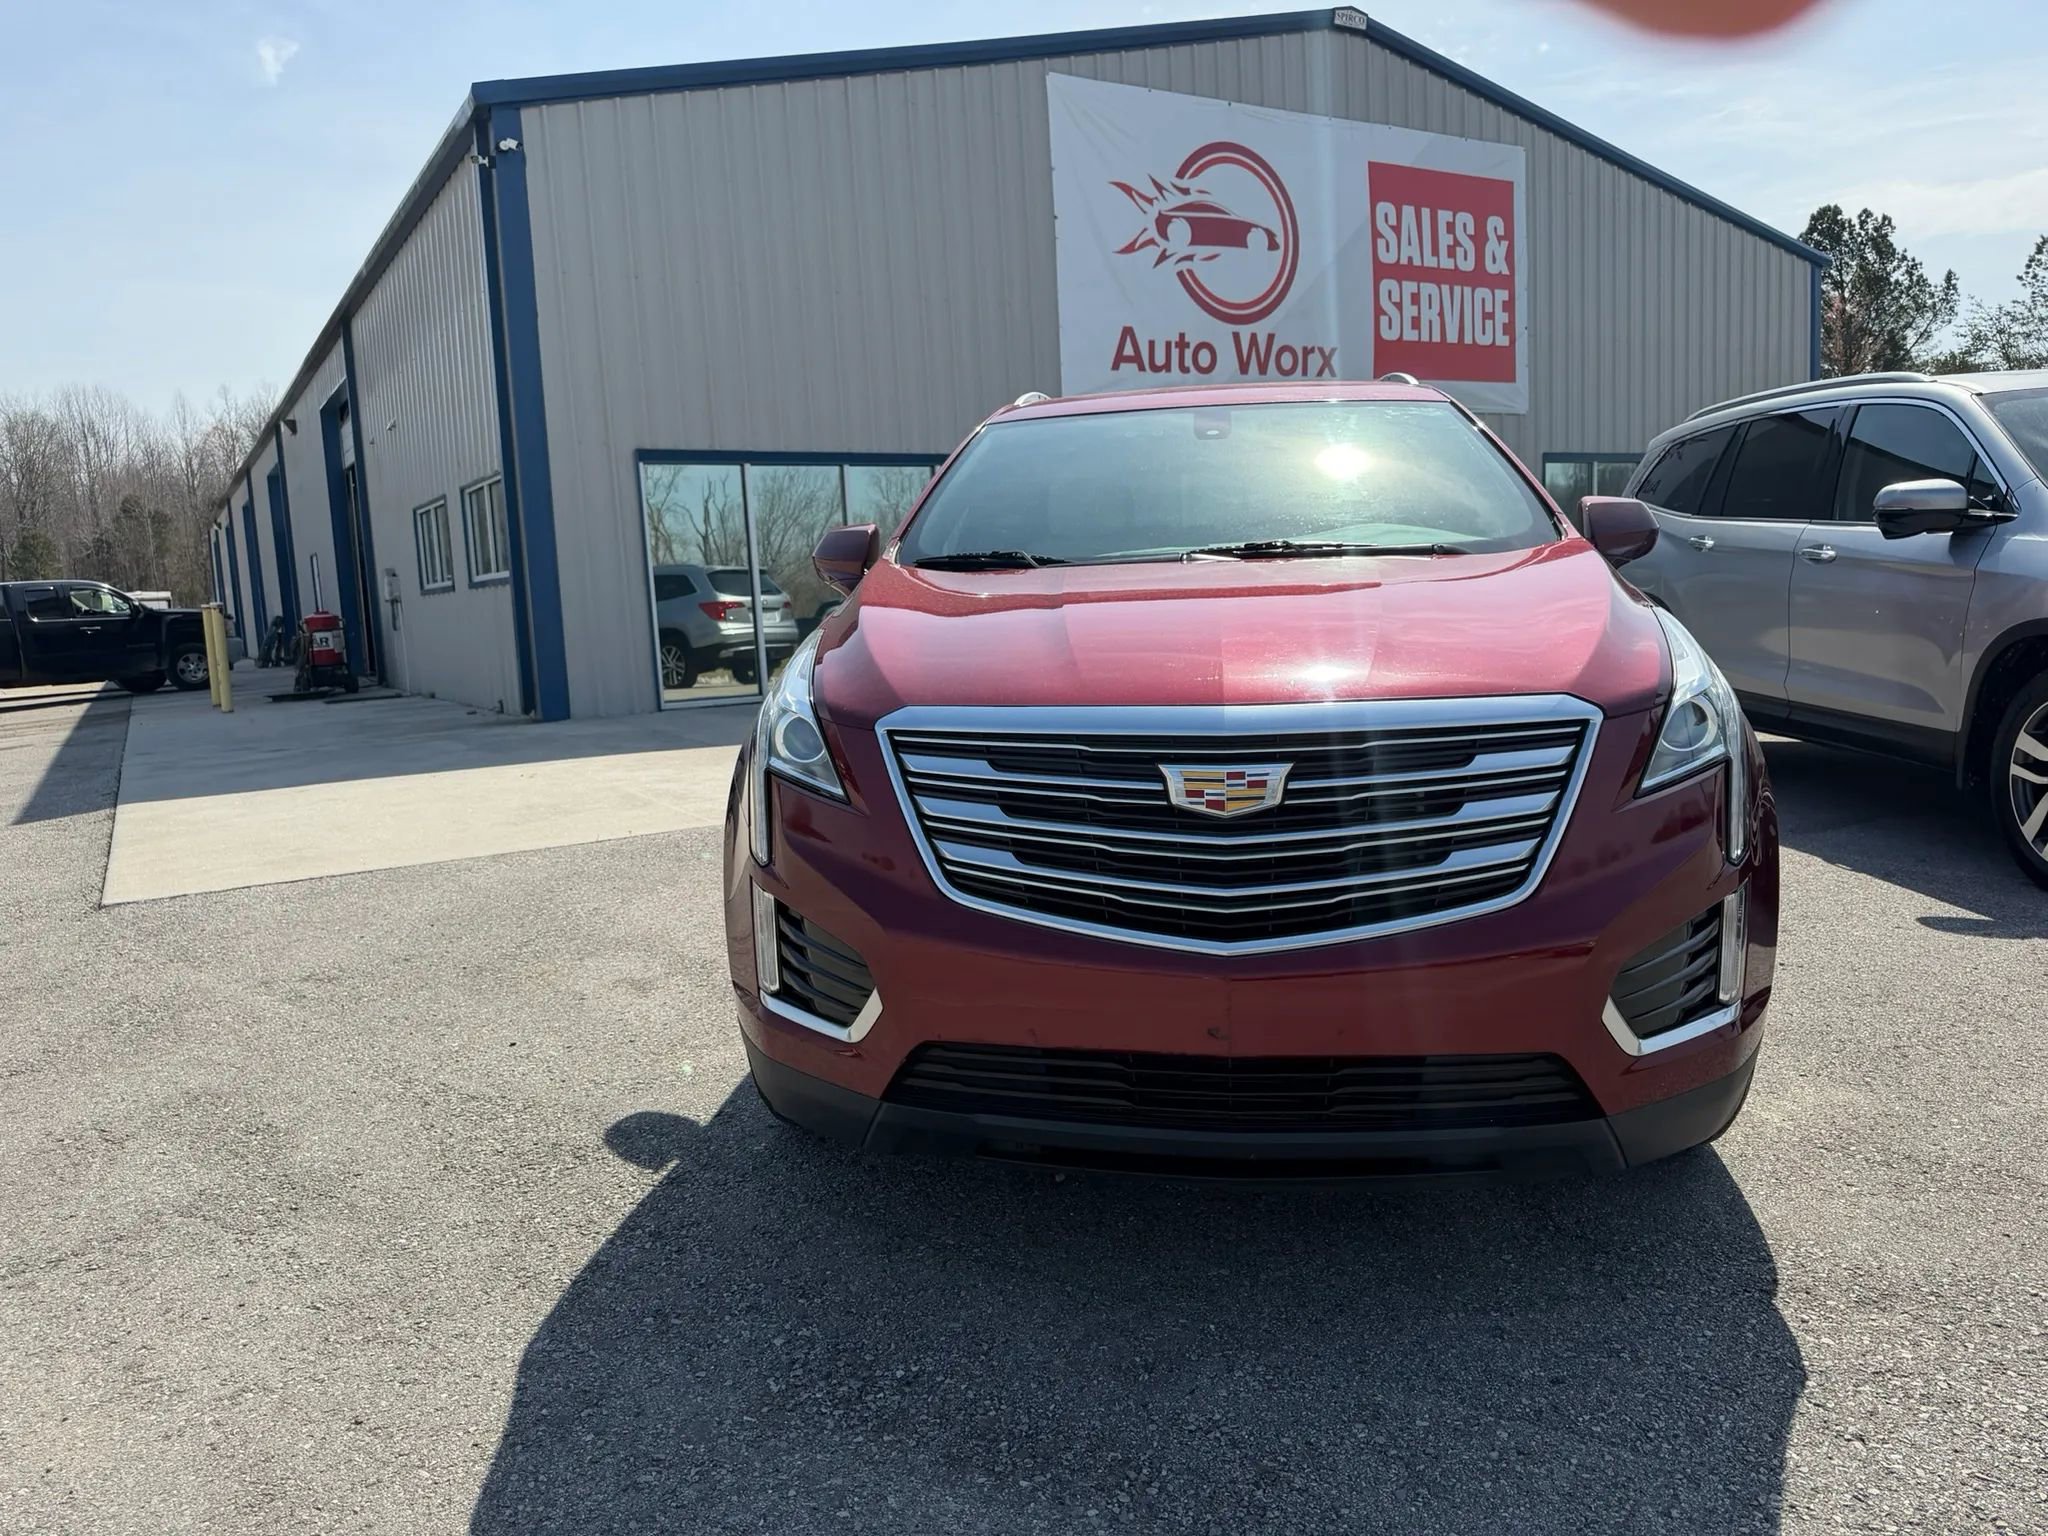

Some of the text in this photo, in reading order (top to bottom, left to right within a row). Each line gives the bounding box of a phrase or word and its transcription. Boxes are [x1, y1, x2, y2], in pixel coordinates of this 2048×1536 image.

[1376, 202, 1509, 275] SALES &
[1378, 278, 1510, 346] SERVICE
[1111, 326, 1338, 378] Auto Worx
